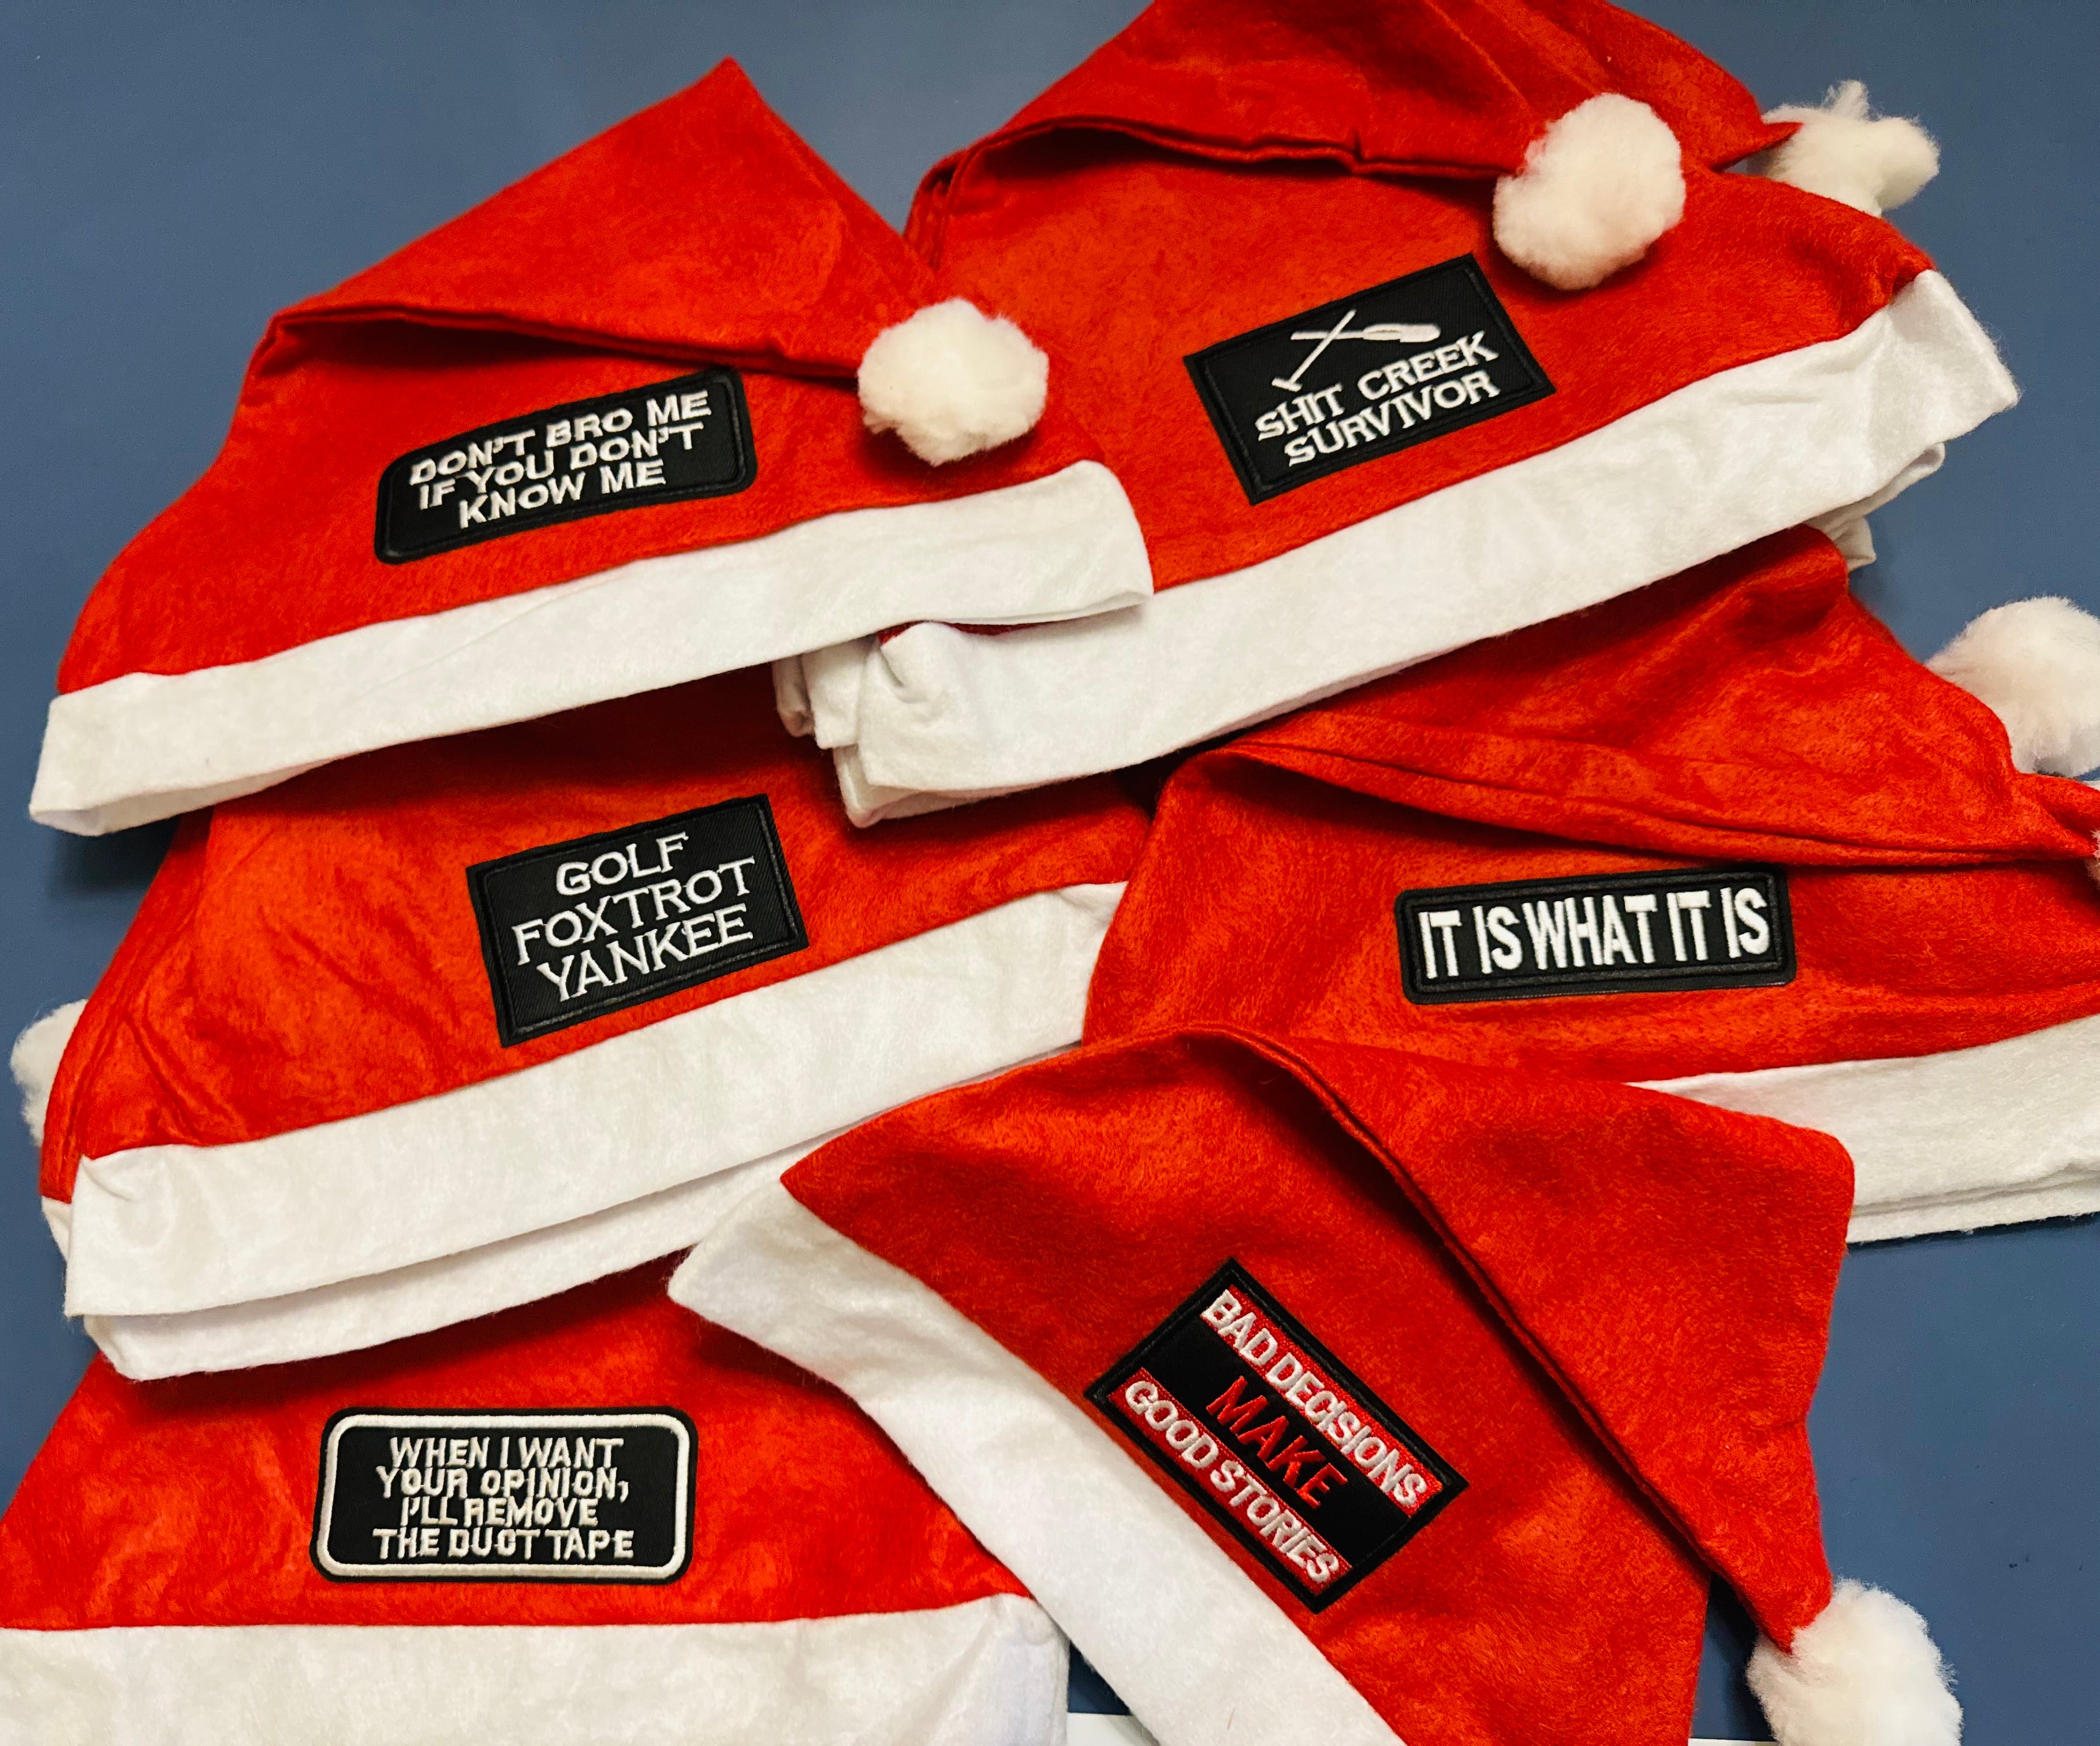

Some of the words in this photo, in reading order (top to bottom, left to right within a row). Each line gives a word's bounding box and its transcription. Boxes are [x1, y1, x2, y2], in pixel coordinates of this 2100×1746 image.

[1255, 382, 1342, 441] SHIT
[1357, 331, 1499, 401] CREEK
[1284, 370, 1501, 467] SURVIVOR
[410, 430, 535, 485] DON'T
[546, 408, 633, 448] BRO
[647, 390, 711, 426] ME
[420, 479, 455, 509] IF
[456, 450, 554, 493] YOU
[570, 423, 703, 470] DON'T
[460, 472, 585, 528] KNOW
[600, 460, 666, 494] ME
[556, 831, 688, 895] GOLF
[512, 856, 755, 965] FOXTROT
[536, 903, 752, 1001] YANKEE
[1418, 910, 1462, 979] IT
[1473, 906, 1522, 974] IS
[1523, 894, 1657, 970] WHAT
[1666, 890, 1711, 961] IT
[1719, 887, 1770, 958] IS
[1203, 1289, 1277, 1366] BAD
[1266, 1352, 1426, 1506] DECISIONS
[1206, 1375, 1348, 1509] MAKE
[375, 1465, 467, 1498] YOUR
[481, 1467, 629, 1502] OPINION,
[390, 1437, 490, 1468] WHEN
[500, 1438, 509, 1468] I
[519, 1437, 623, 1468] WANT
[1125, 1381, 1217, 1468] GOOD
[1211, 1460, 1338, 1583] STORIES
[373, 1527, 439, 1559] THE
[448, 1528, 540, 1559] DUCT
[544, 1528, 633, 1560] TAPE
[401, 1497, 457, 1526] I'LL
[464, 1497, 598, 1527] REMOVE
